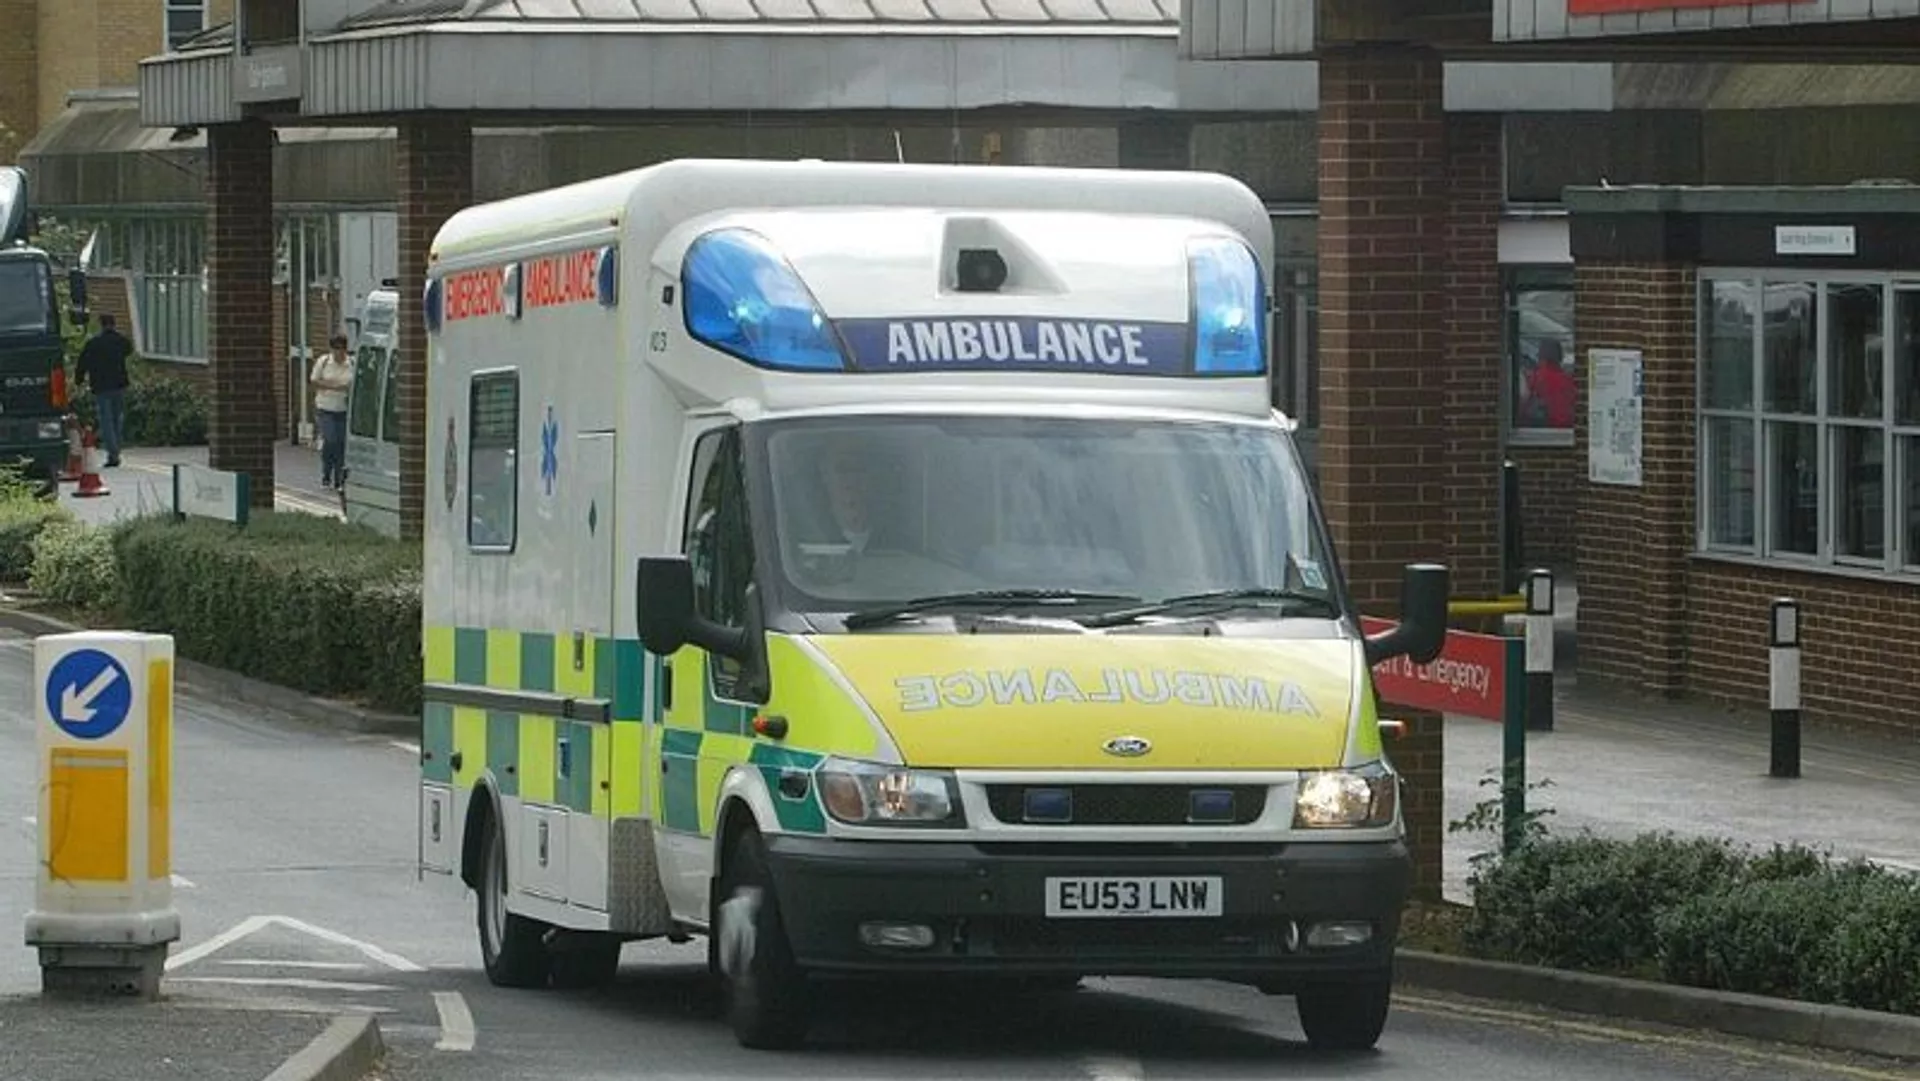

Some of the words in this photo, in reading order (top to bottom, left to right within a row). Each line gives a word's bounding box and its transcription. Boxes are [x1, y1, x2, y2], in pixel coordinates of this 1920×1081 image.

[446, 268, 505, 320] EMERGENC
[527, 249, 596, 307] AMBULANCE
[888, 320, 1149, 366] AMBULANCE
[1059, 881, 1140, 910] EU53
[1150, 881, 1208, 910] LNW
